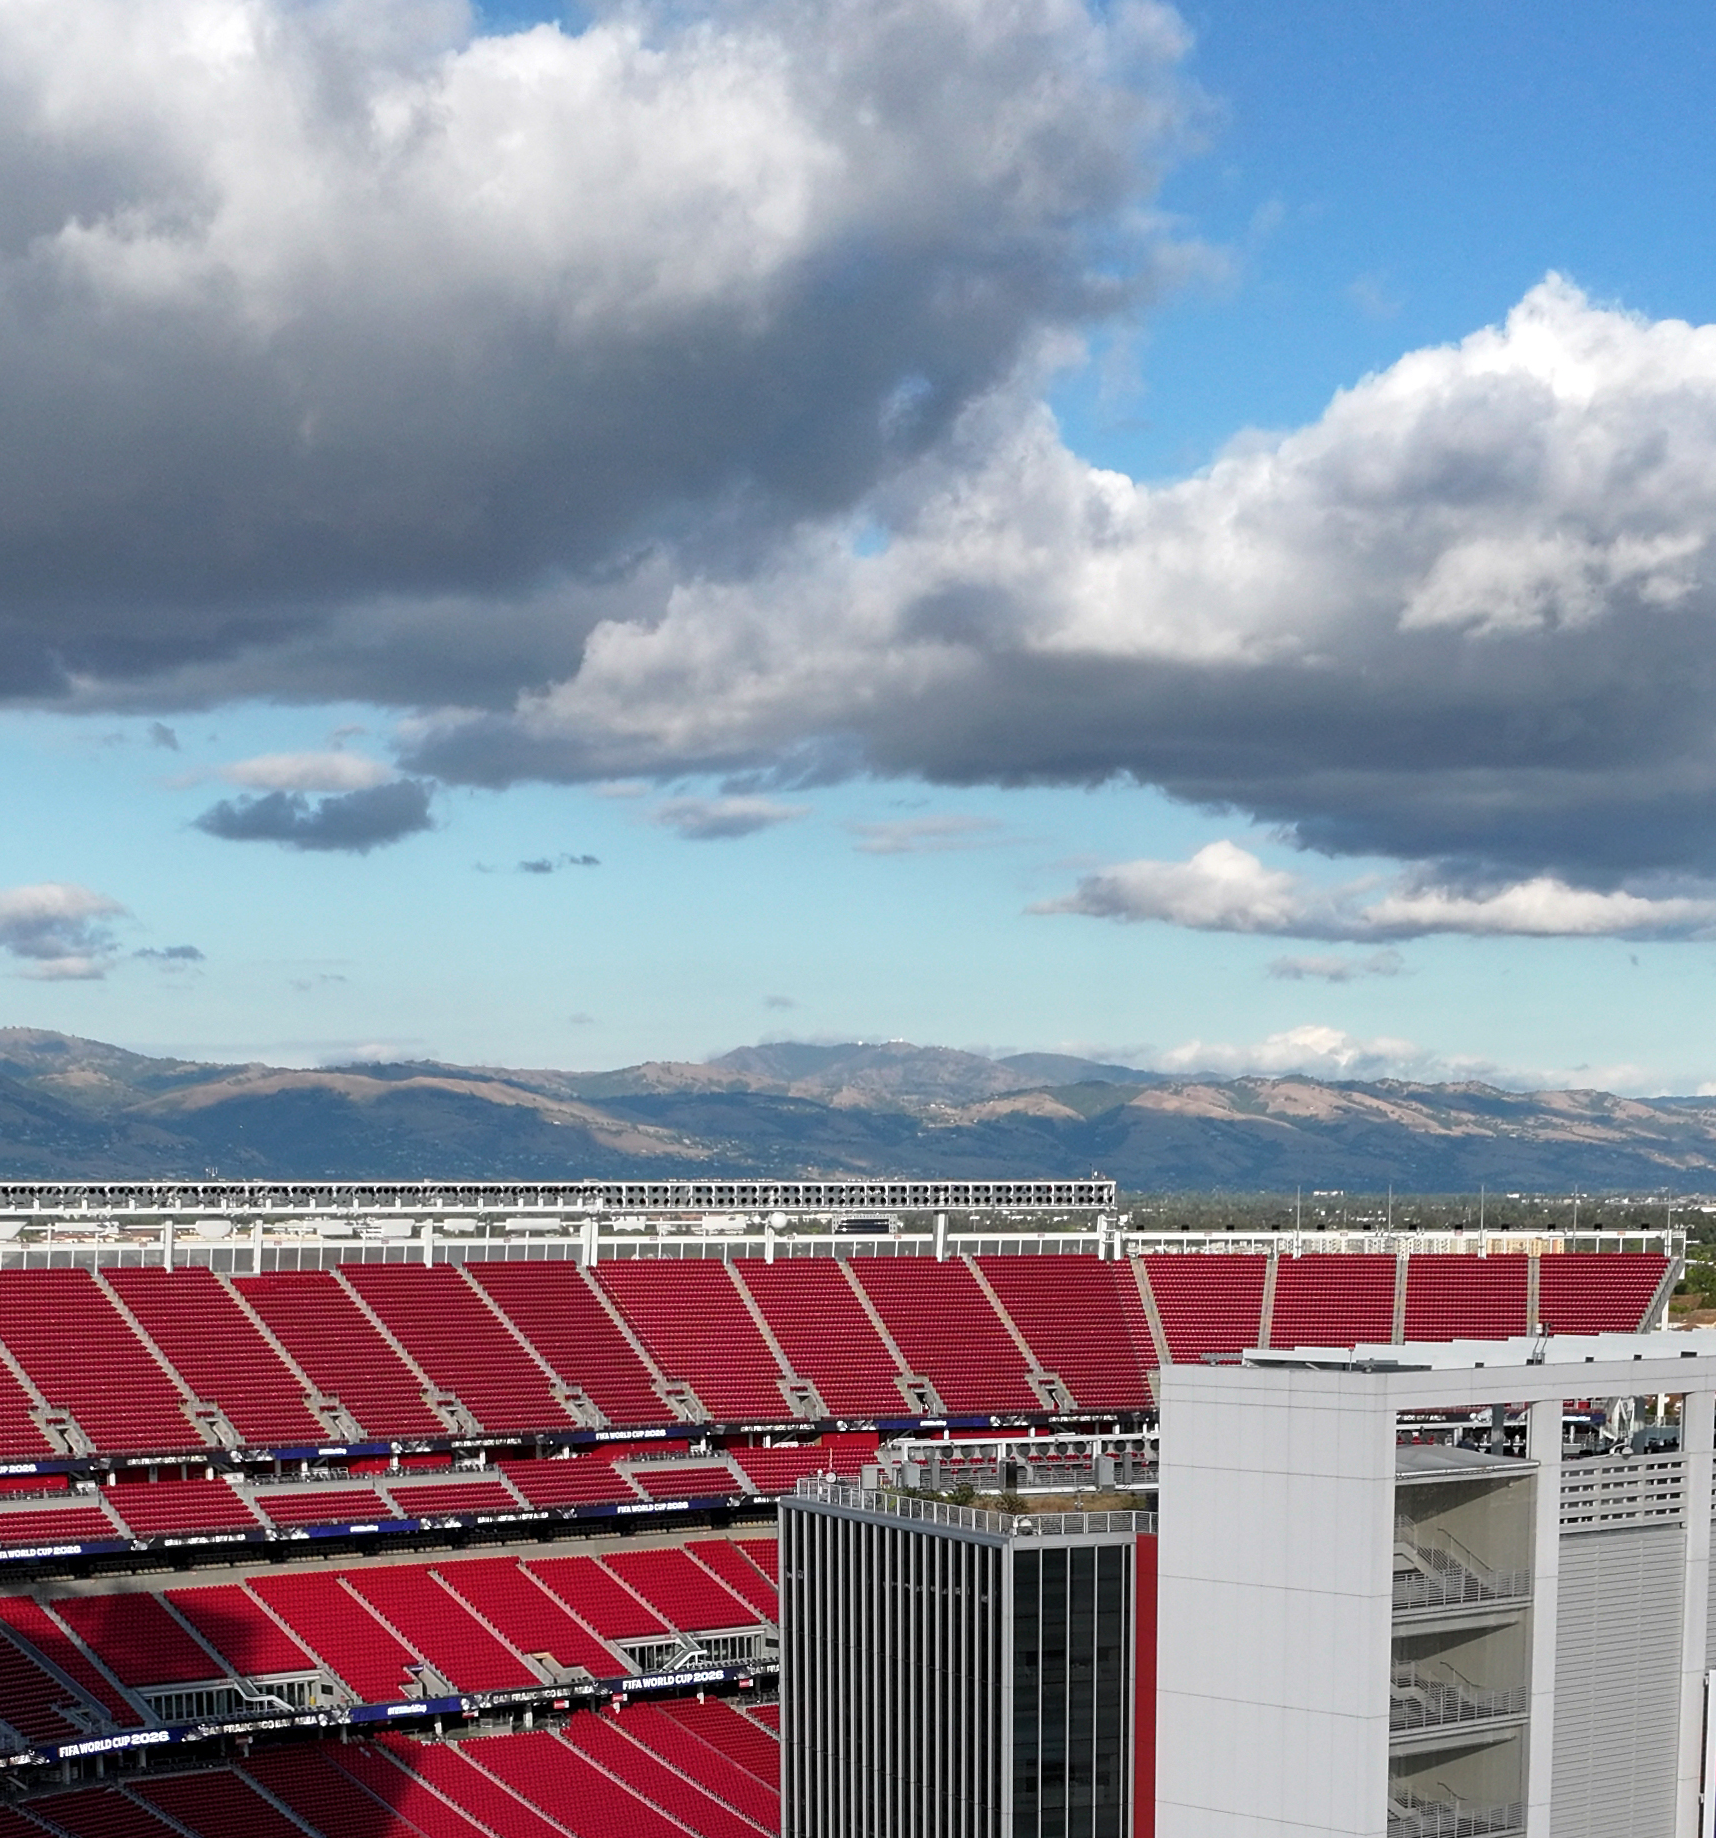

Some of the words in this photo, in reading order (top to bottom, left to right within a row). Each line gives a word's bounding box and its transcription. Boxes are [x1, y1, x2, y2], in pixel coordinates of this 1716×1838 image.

[622, 1680, 643, 1690] FIFA
[643, 1676, 675, 1688] WORLD
[675, 1674, 693, 1685] CUP
[693, 1670, 725, 1682] 2026
[59, 1744, 80, 1757] FIFA
[79, 1738, 112, 1754] WORLD
[113, 1735, 130, 1748] CUP
[131, 1730, 170, 1745] 2026
